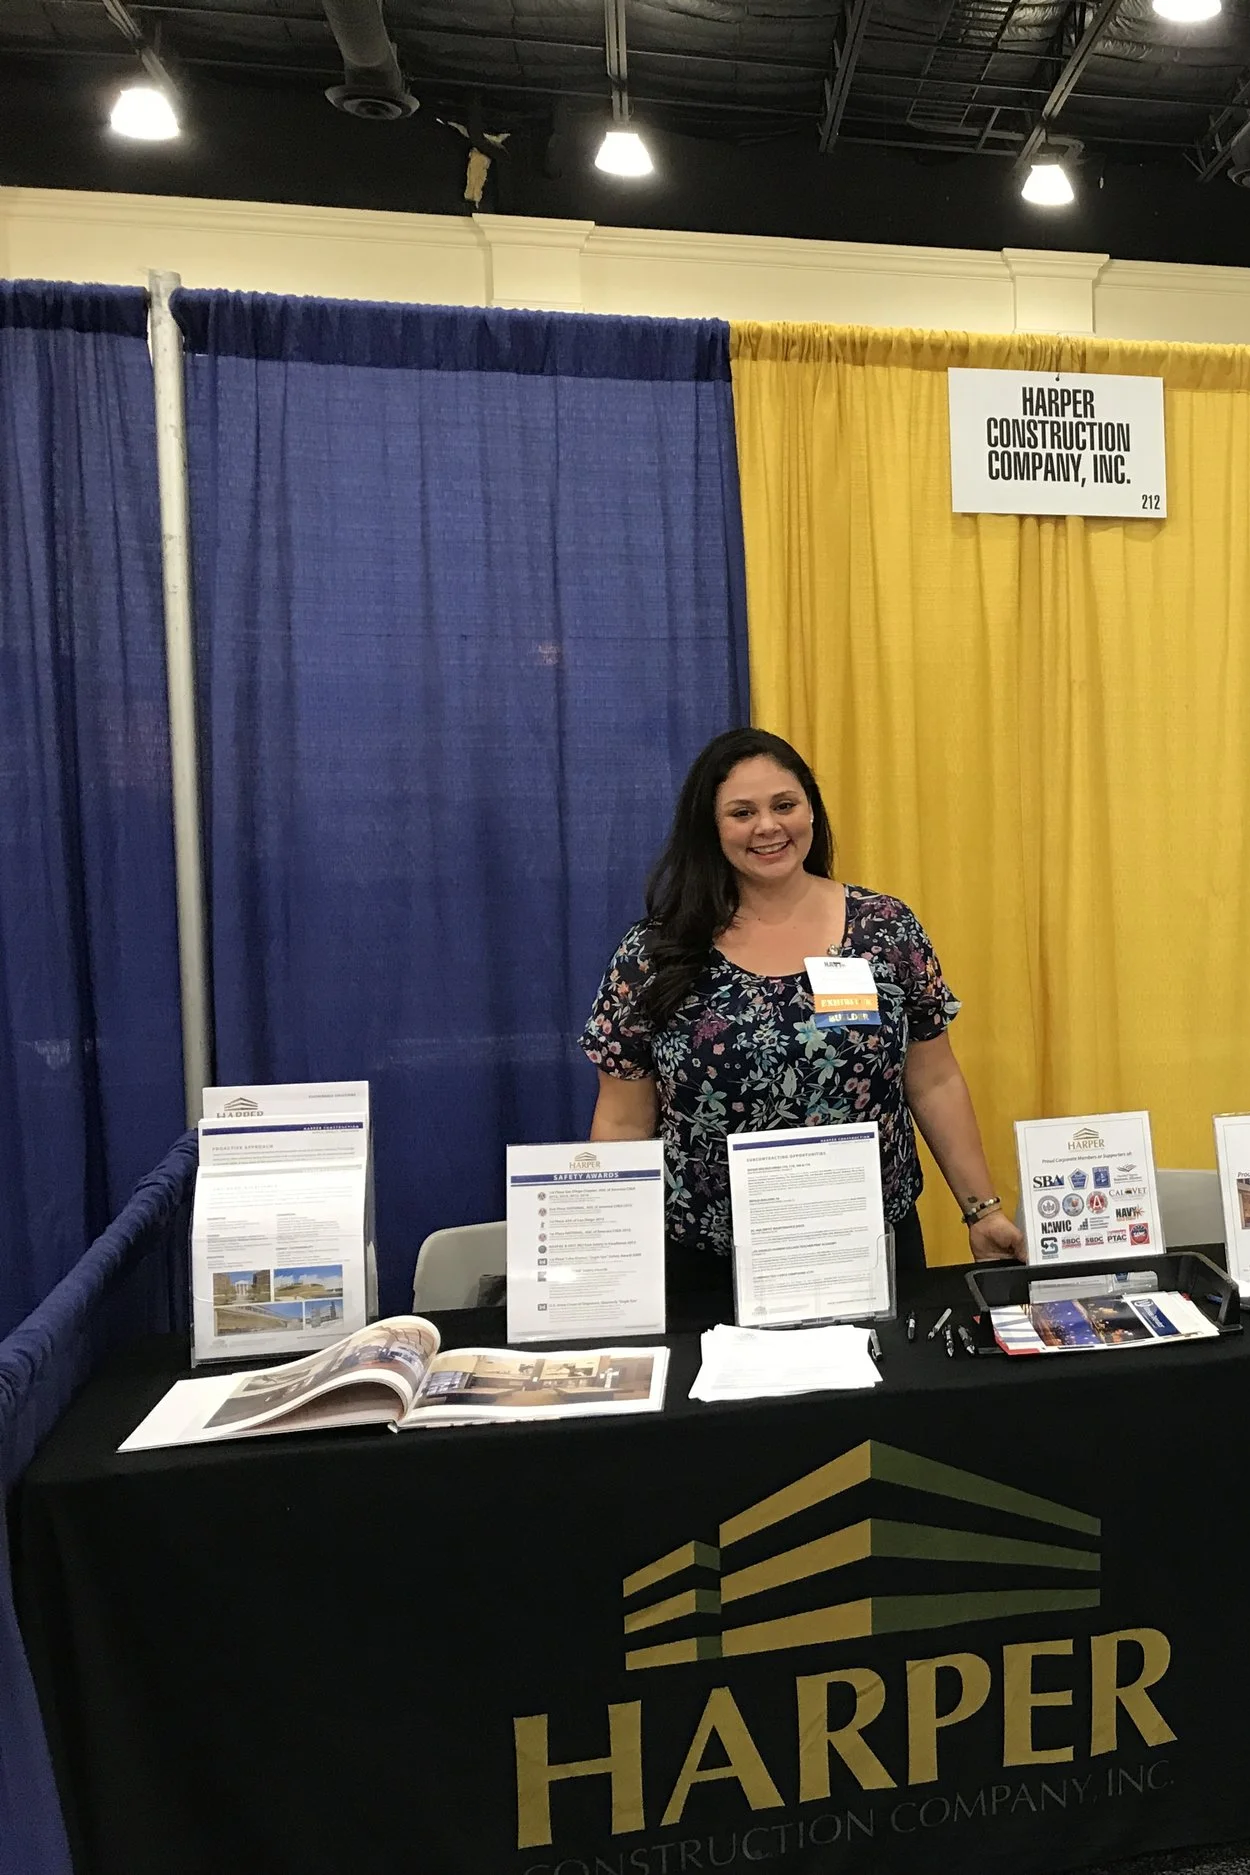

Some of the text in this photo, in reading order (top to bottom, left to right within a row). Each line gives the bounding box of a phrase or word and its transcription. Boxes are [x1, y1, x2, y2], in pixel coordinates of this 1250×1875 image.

[1022, 386, 1095, 418] HARPER
[986, 417, 1131, 452] CONSTRUCTION
[988, 450, 1131, 487] COMPANY, INC.
[1142, 494, 1160, 510] 212
[1068, 1139, 1104, 1150] HARPER
[569, 1161, 601, 1169] HARPER
[553, 1173, 583, 1181] SAFETY
[1033, 1174, 1064, 1188] SBA
[1116, 1206, 1137, 1218] NAVY
[1041, 1219, 1072, 1234] NAWIC
[1107, 1234, 1127, 1242] PTAC
[513, 1627, 1178, 1851] HARPER
[1107, 1758, 1175, 1797] INC.
